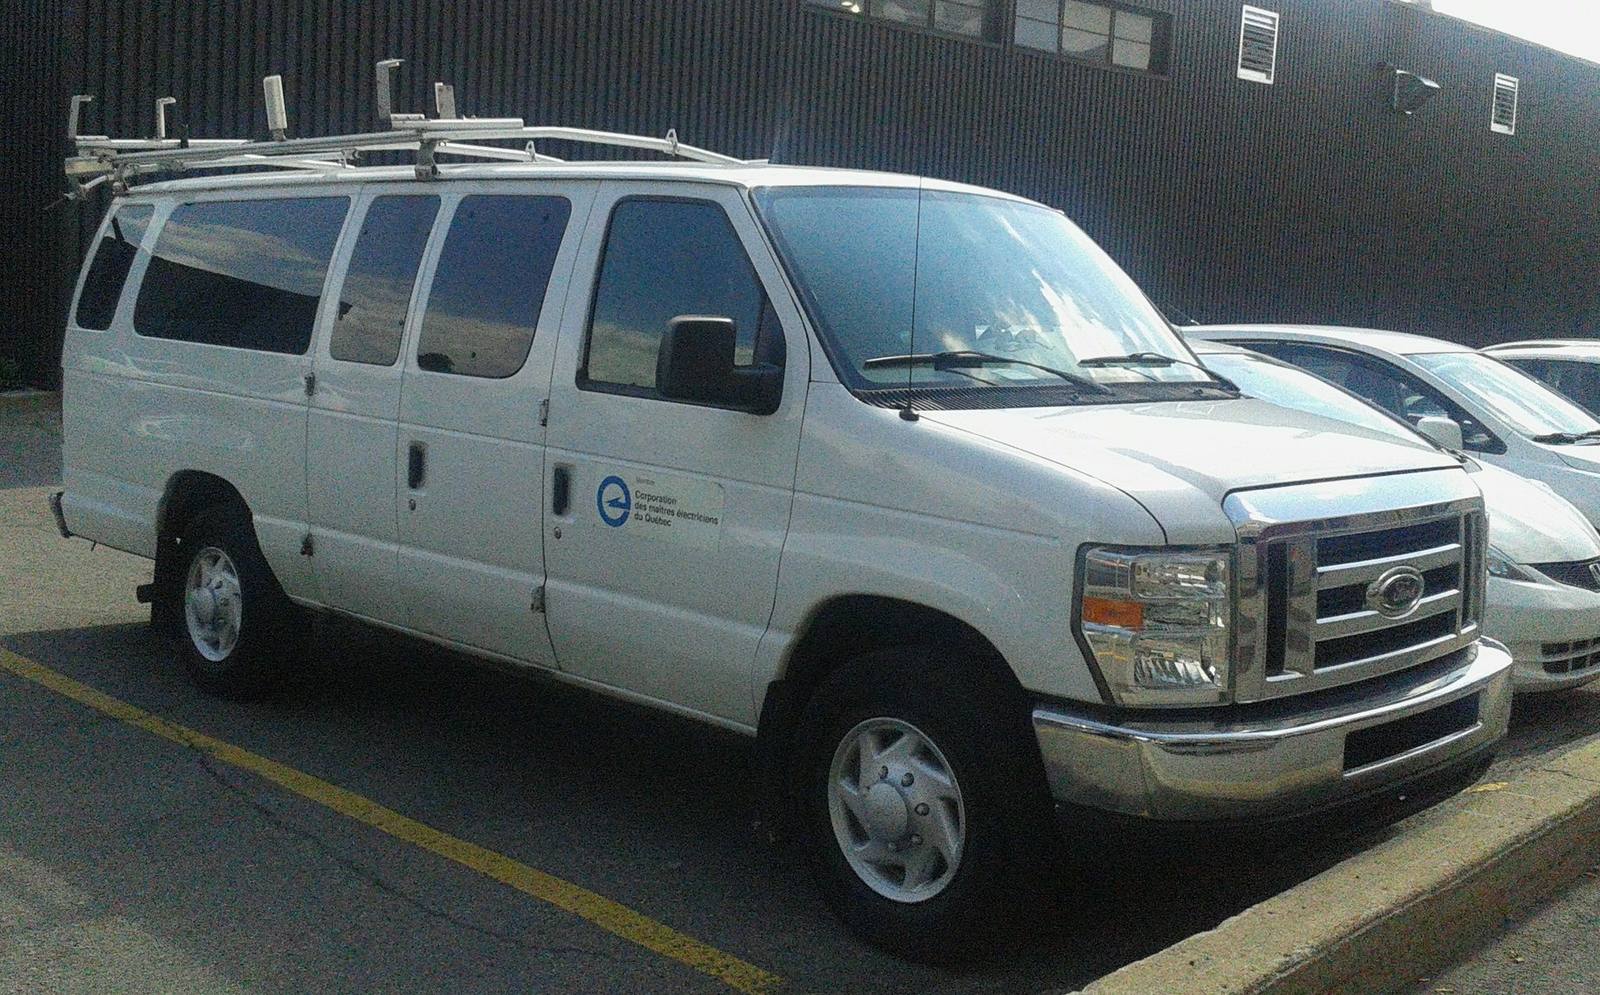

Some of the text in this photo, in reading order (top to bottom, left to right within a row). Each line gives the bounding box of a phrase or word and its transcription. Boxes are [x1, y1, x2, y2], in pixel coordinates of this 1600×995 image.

[635, 490, 677, 505] Corporation
[634, 502, 647, 511] des
[677, 508, 719, 525] électriciens
[634, 513, 672, 526] du Québec
